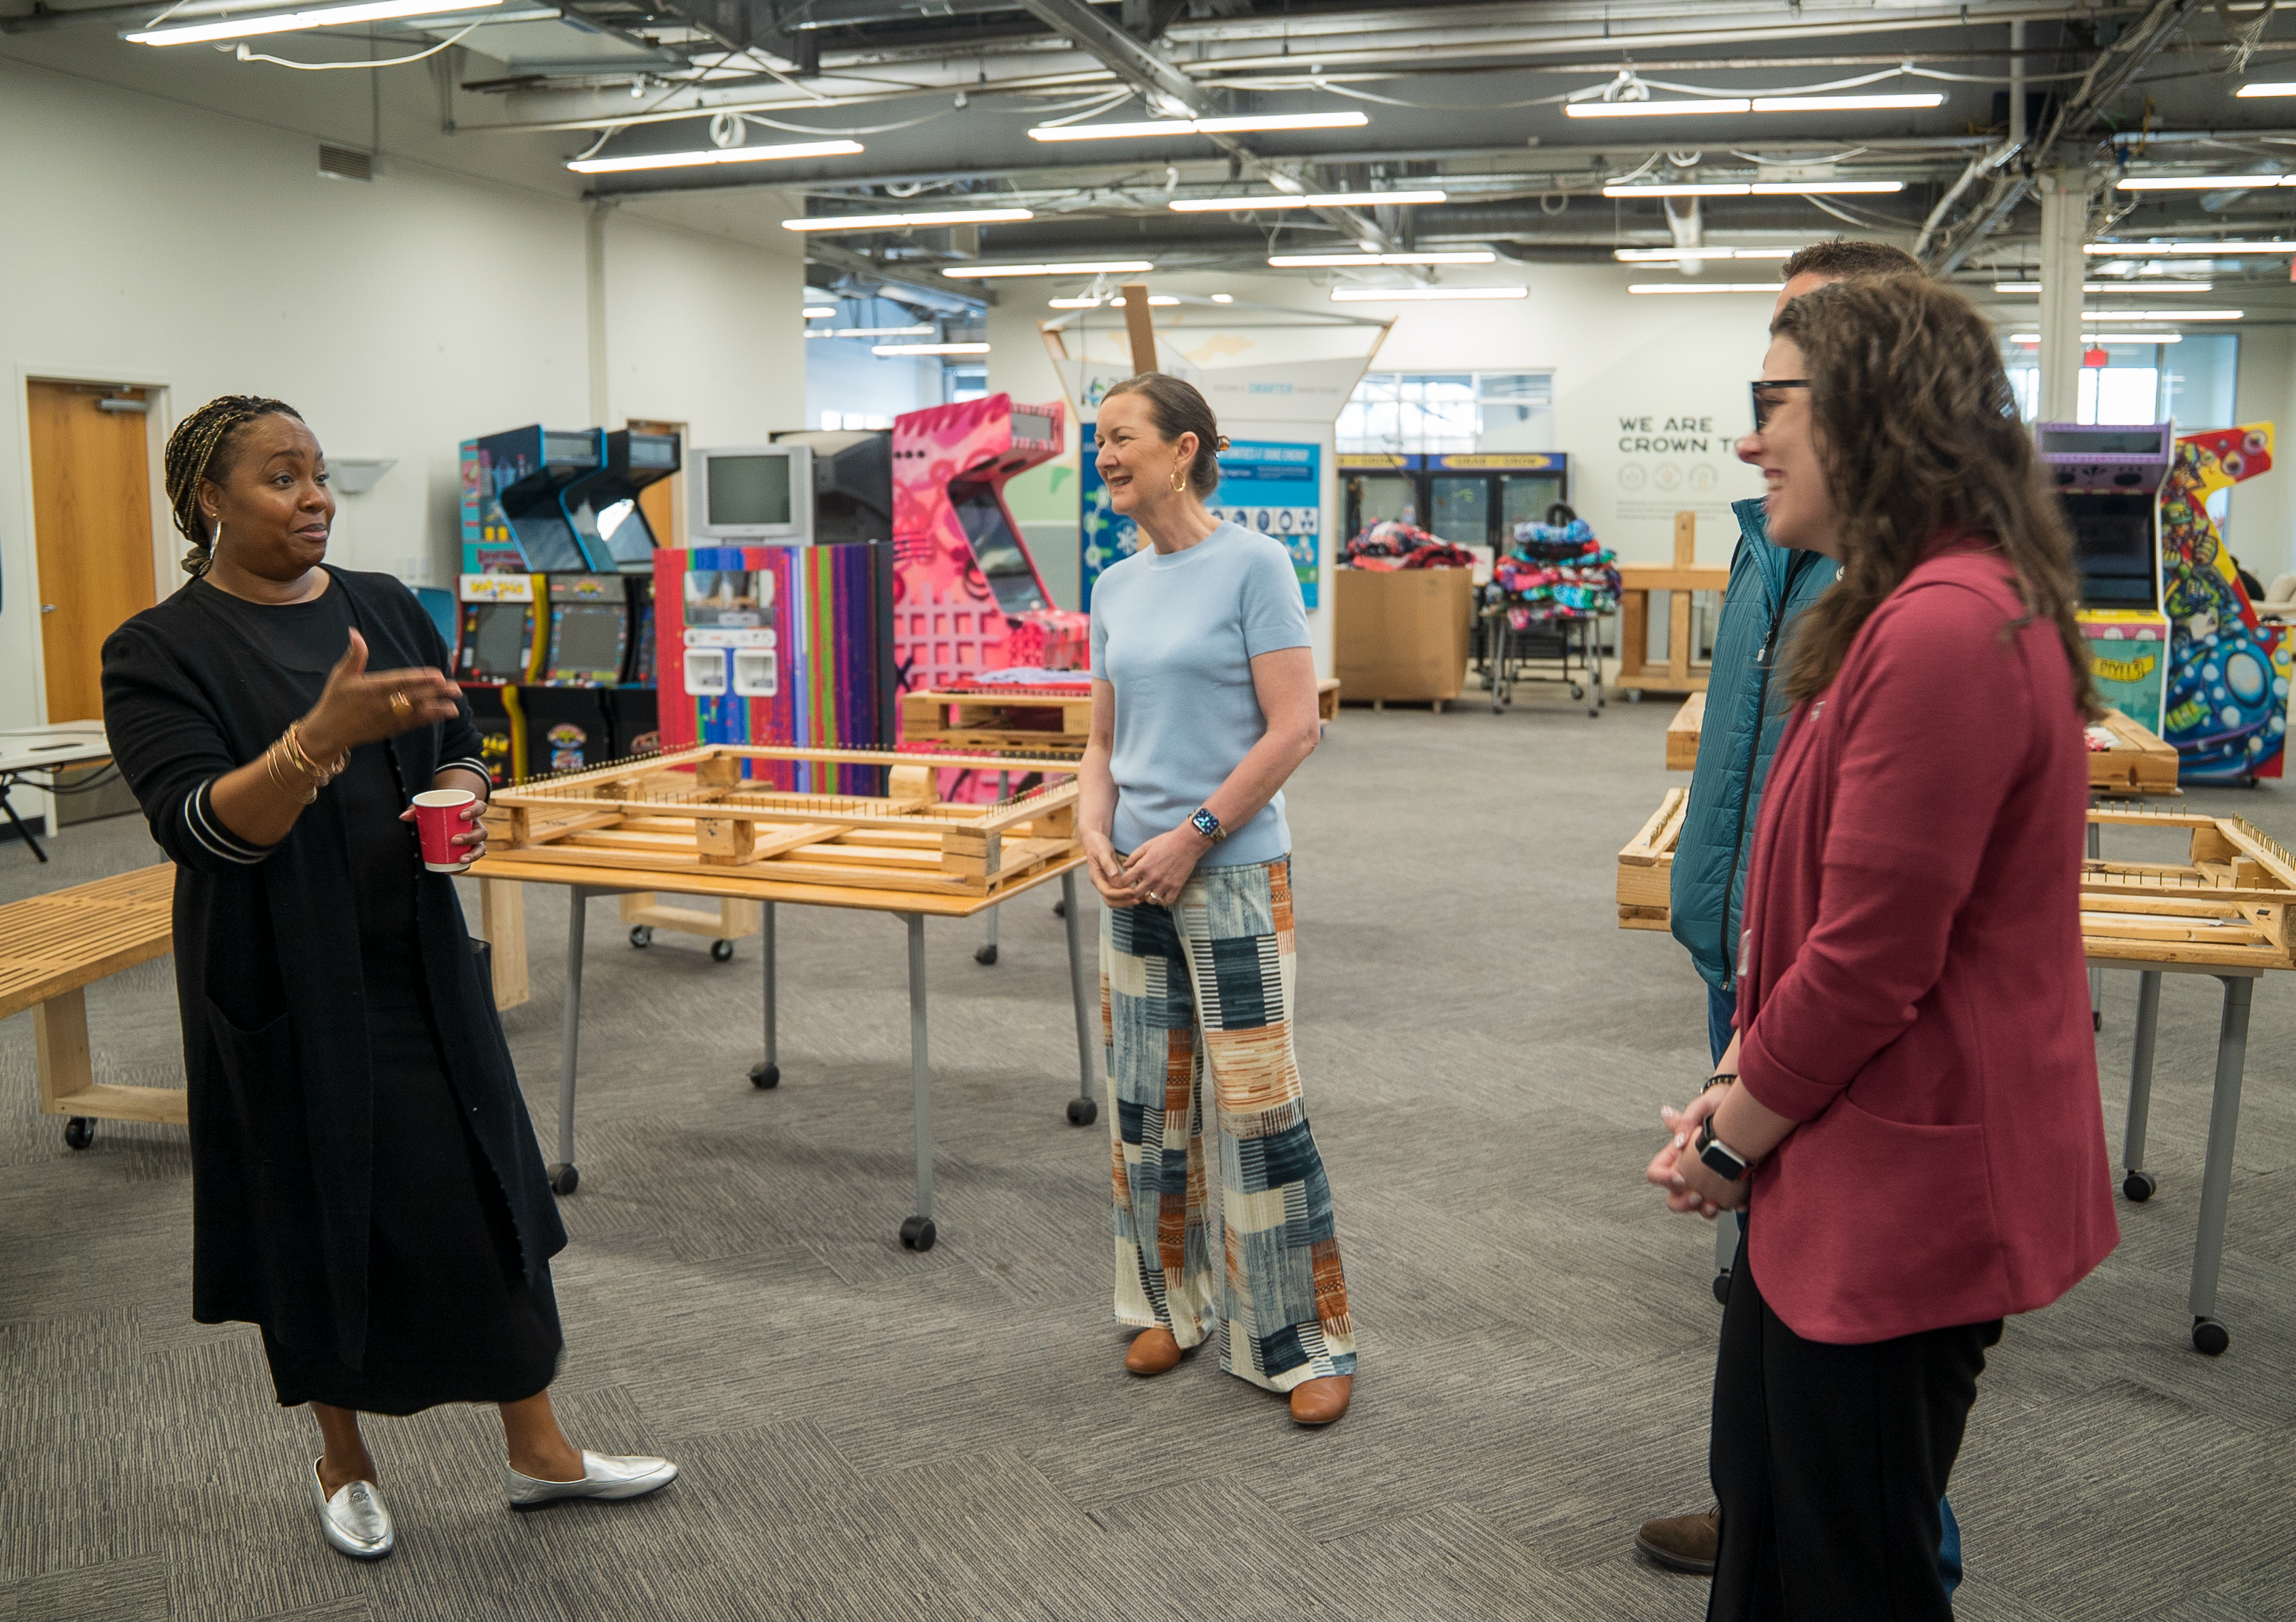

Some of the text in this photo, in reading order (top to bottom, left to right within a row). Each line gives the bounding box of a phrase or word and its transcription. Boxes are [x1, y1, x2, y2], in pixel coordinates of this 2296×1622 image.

[1619, 416, 1712, 433] WE ARE
[1618, 437, 1707, 452] CROWN
